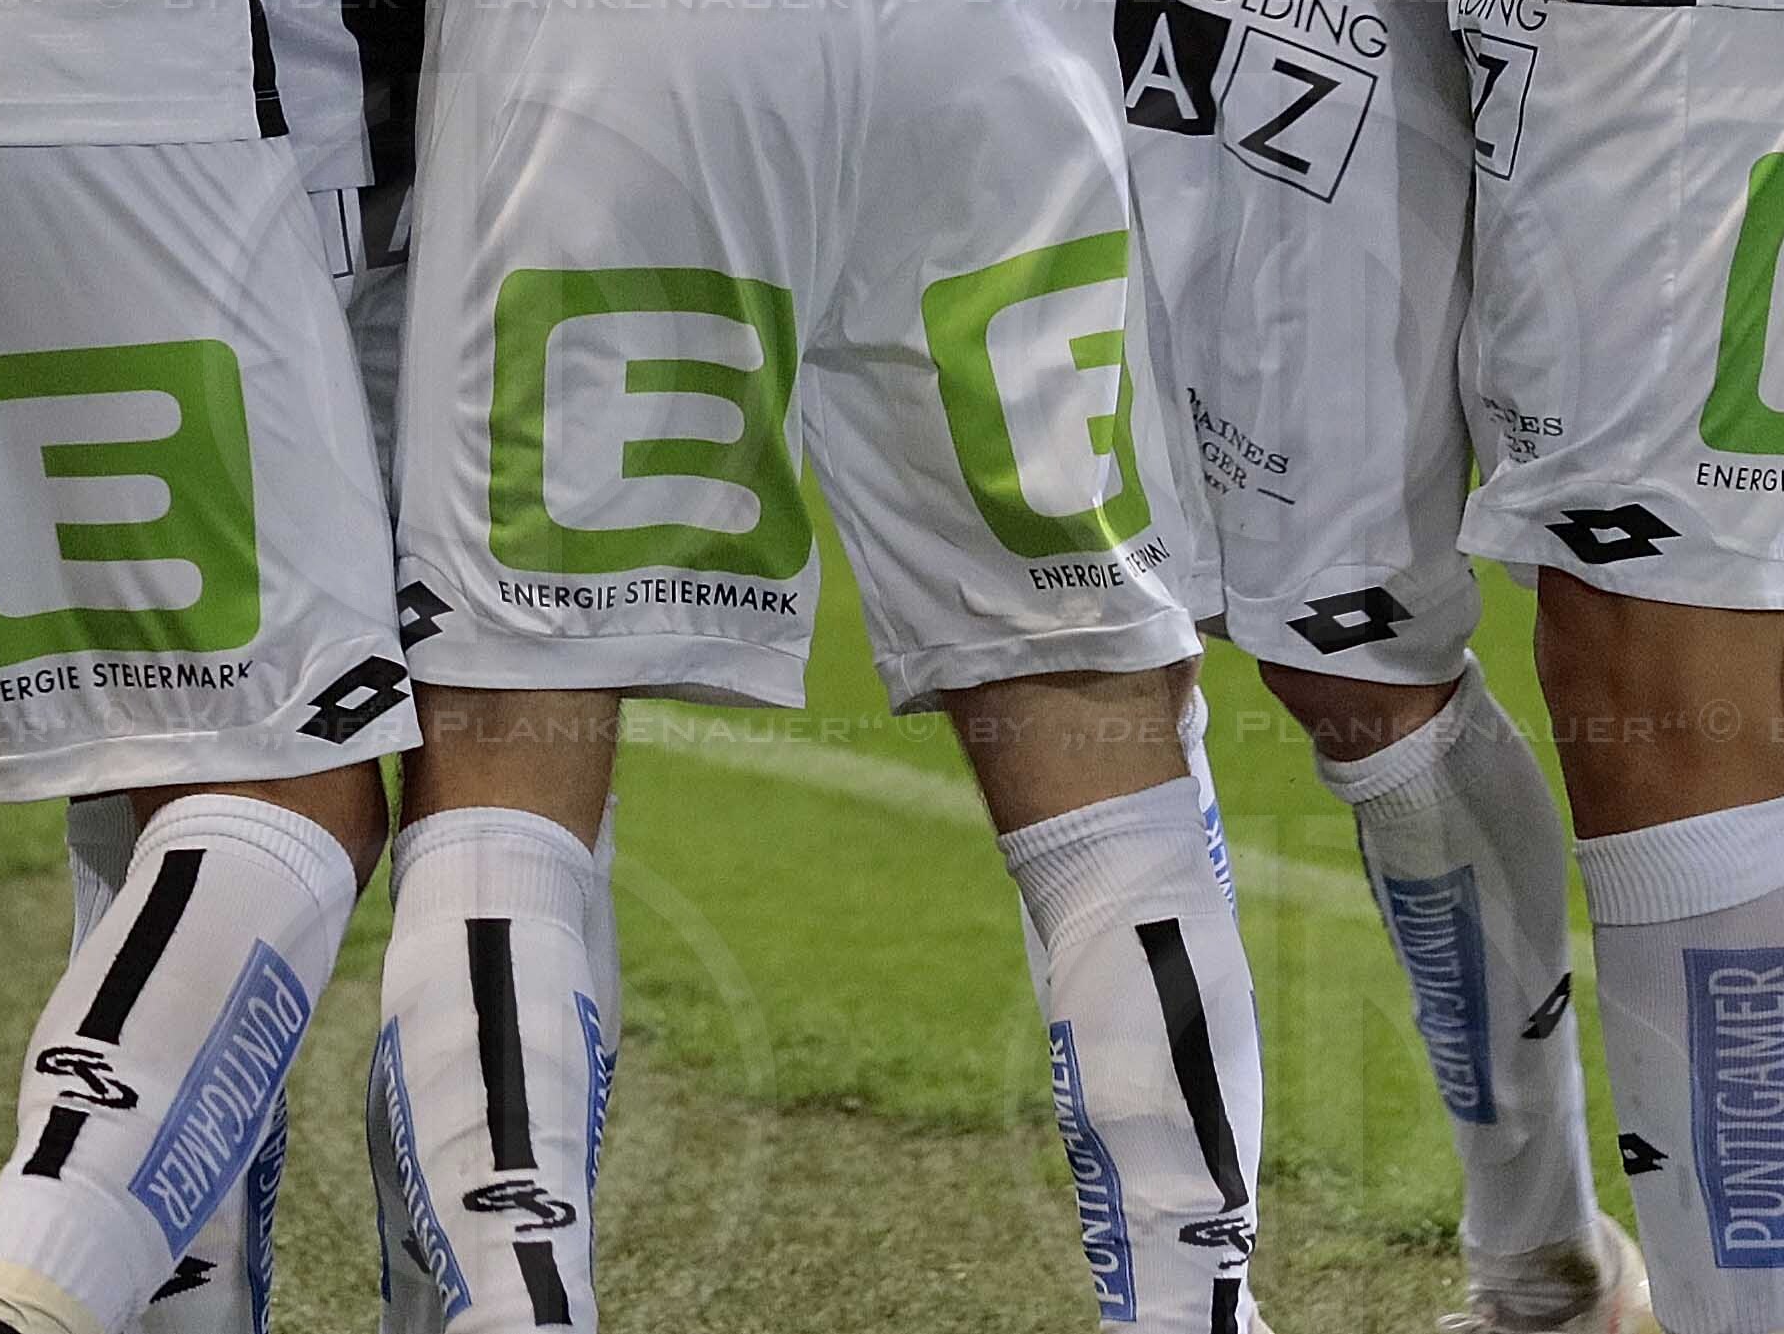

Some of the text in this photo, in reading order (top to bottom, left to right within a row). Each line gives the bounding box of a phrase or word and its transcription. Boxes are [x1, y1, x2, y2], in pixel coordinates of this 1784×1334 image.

[1028, 562, 1124, 590] ENERGIE
[498, 580, 799, 616] ENERGIE STEIERMARK
[92, 660, 254, 690] STEIERMARK
[150, 961, 304, 1234] PUNTIGAMER
